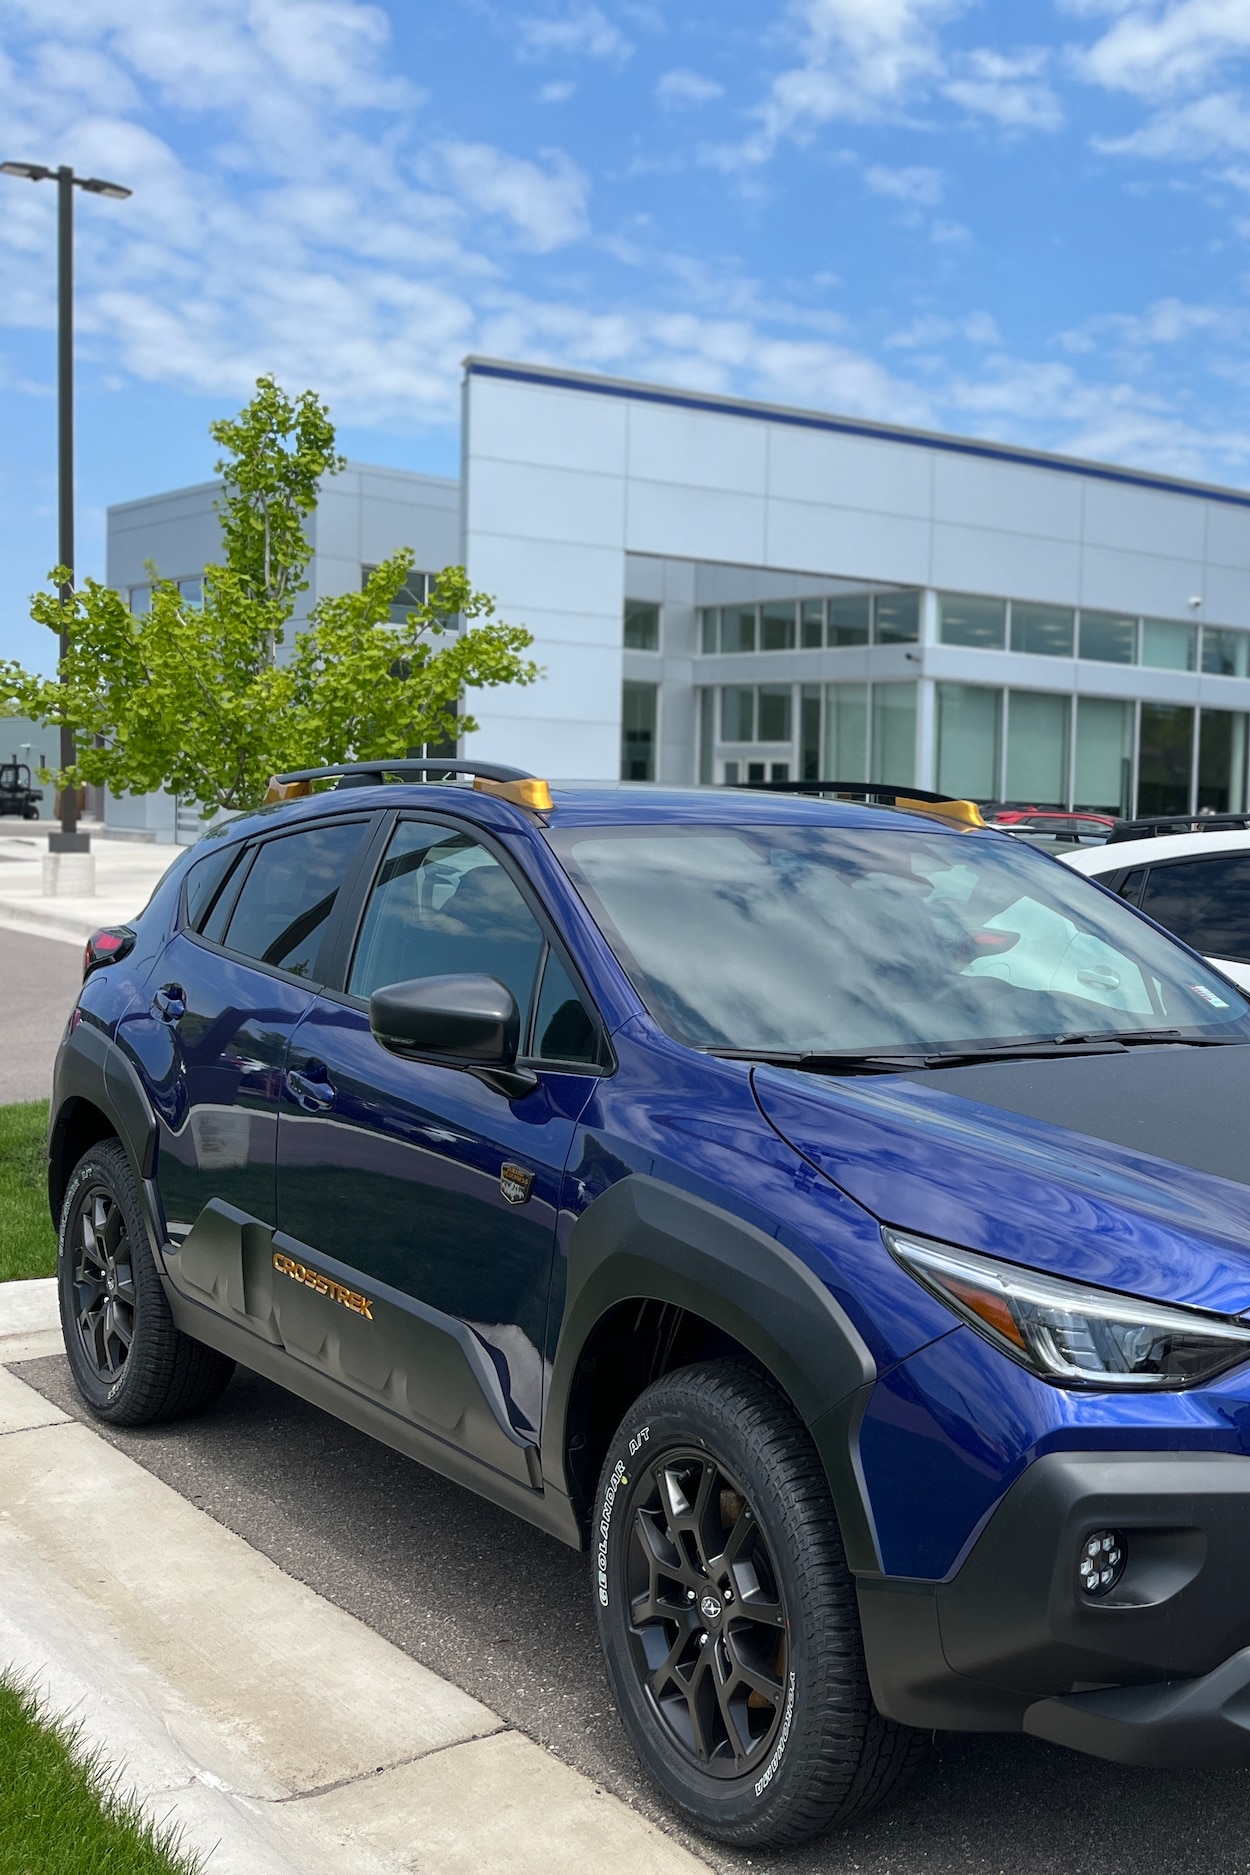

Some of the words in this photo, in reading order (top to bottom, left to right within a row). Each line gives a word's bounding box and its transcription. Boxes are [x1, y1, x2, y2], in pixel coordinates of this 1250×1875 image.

[273, 1252, 374, 1320] CROSSTREK
[598, 1460, 626, 1606] GEOLANDAR
[628, 1426, 651, 1457] A/T
[754, 1671, 796, 1797] YOKOHAMA
